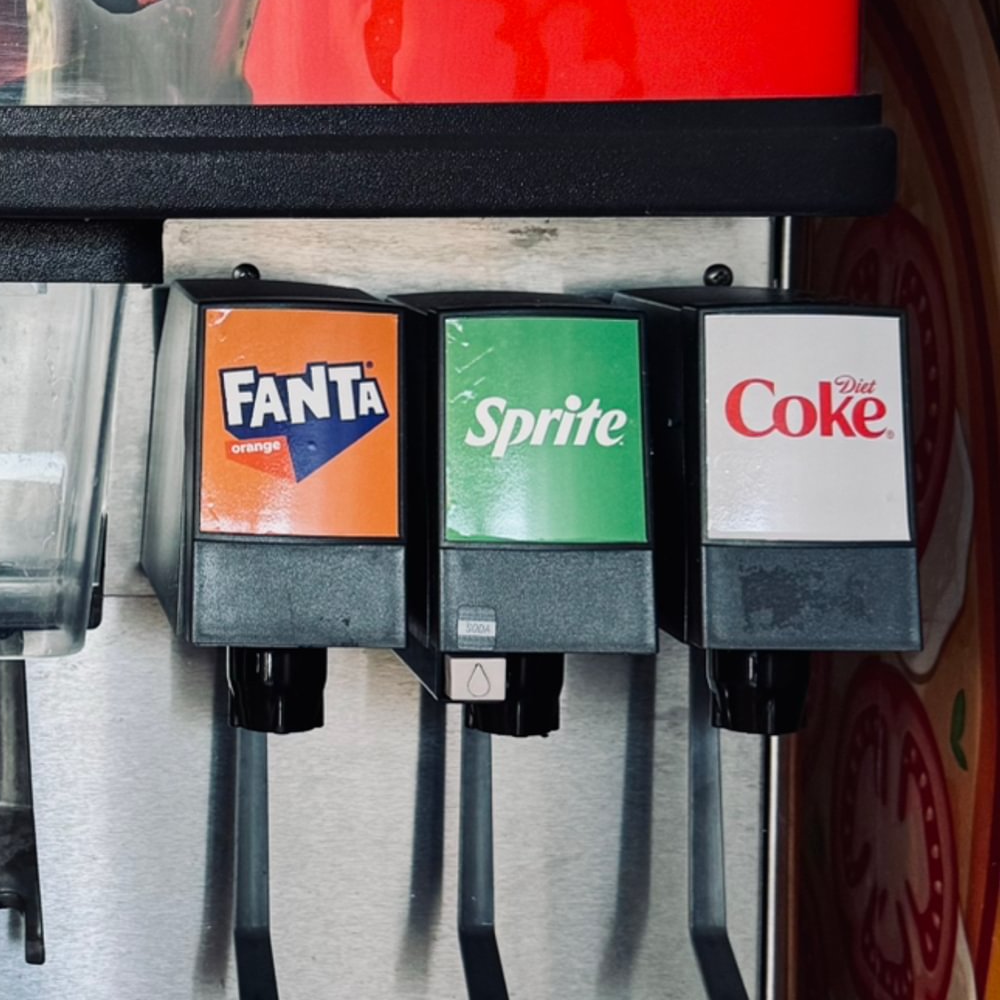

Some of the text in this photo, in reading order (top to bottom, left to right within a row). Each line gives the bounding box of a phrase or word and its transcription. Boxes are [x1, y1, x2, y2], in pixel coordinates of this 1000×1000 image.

[834, 374, 877, 394] Diet
[464, 394, 628, 458] Sprite
[725, 378, 888, 439] Coke
[230, 440, 282, 455] orange
